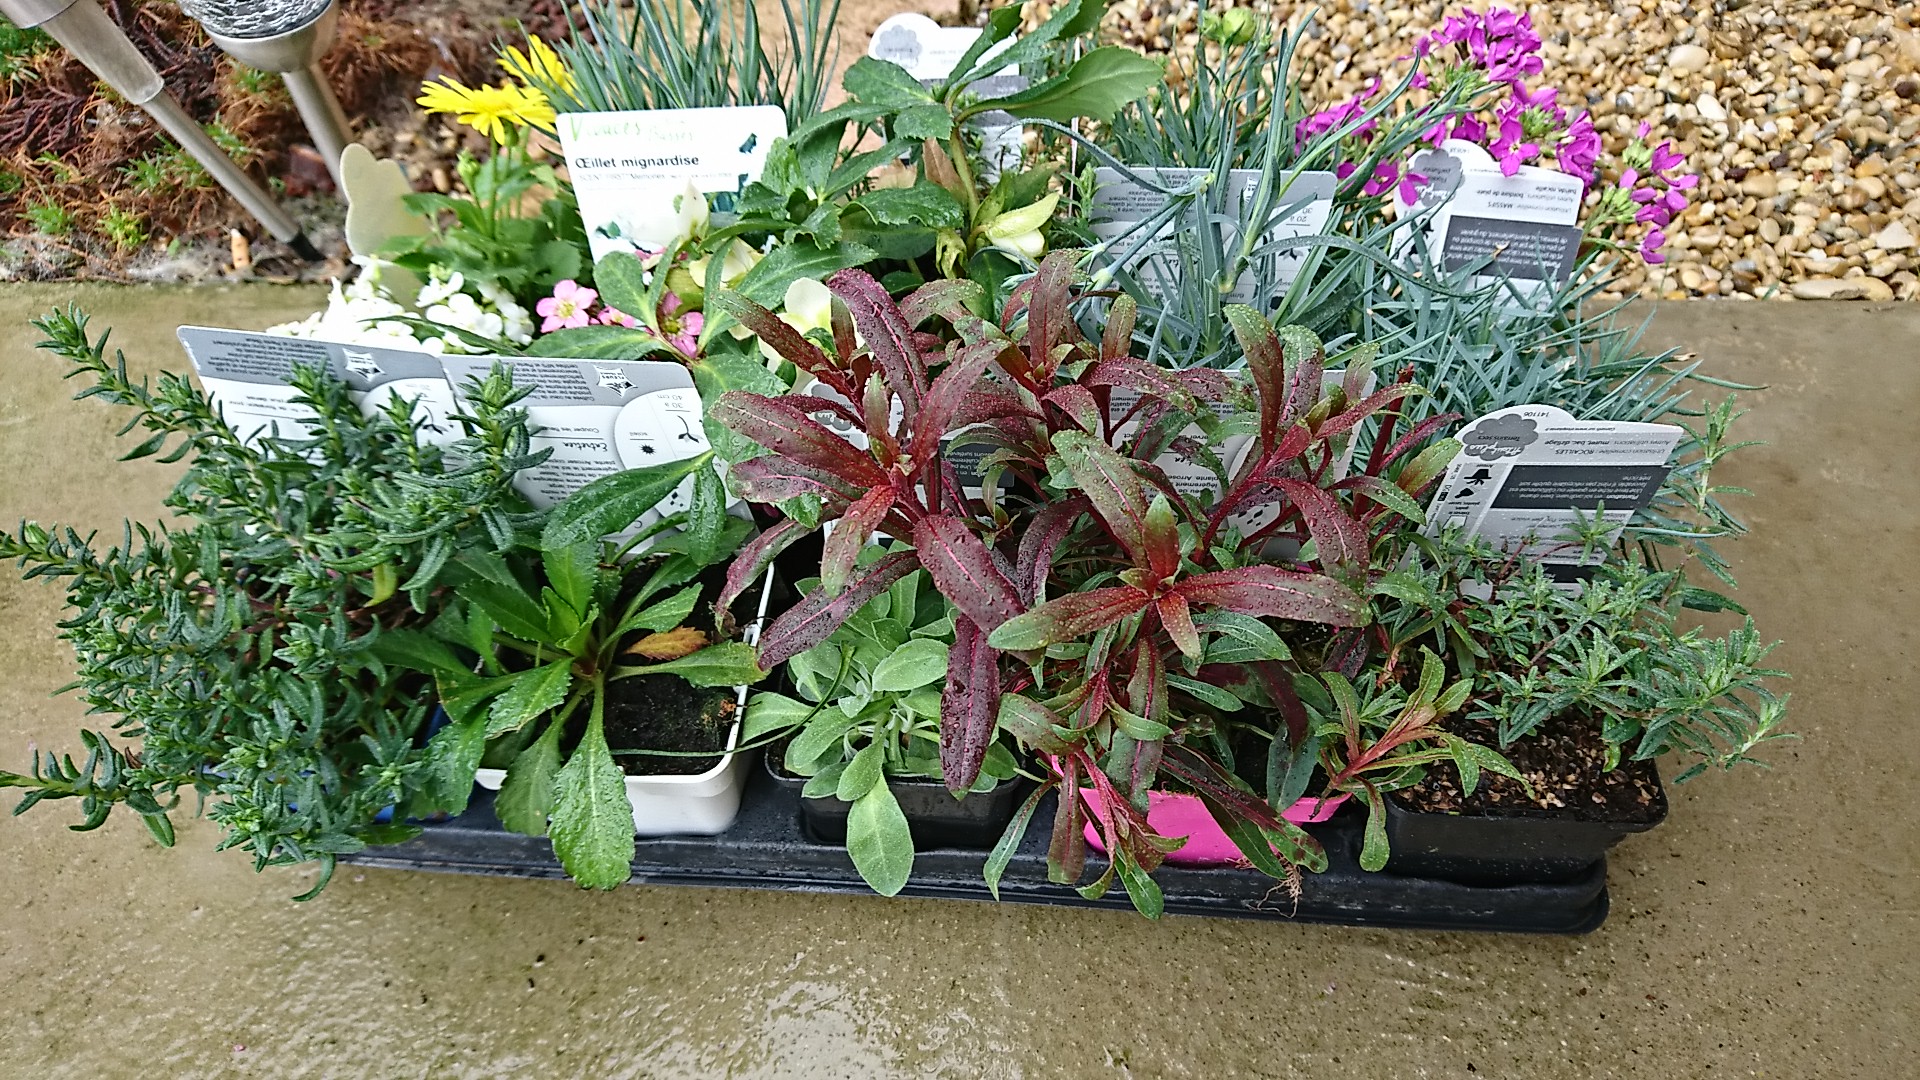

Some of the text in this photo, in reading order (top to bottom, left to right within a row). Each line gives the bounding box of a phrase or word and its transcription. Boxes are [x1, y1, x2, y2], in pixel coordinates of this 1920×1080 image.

[575, 155, 699, 169] Œillet mignardise
[1414, 183, 1434, 198] plu
[1501, 190, 1524, 198] bordure
[1488, 201, 1514, 209] MASSIFS
[817, 412, 836, 423] lus
[574, 426, 599, 434] Couper
[562, 442, 608, 452] Entretien
[1469, 442, 1498, 454] plus
